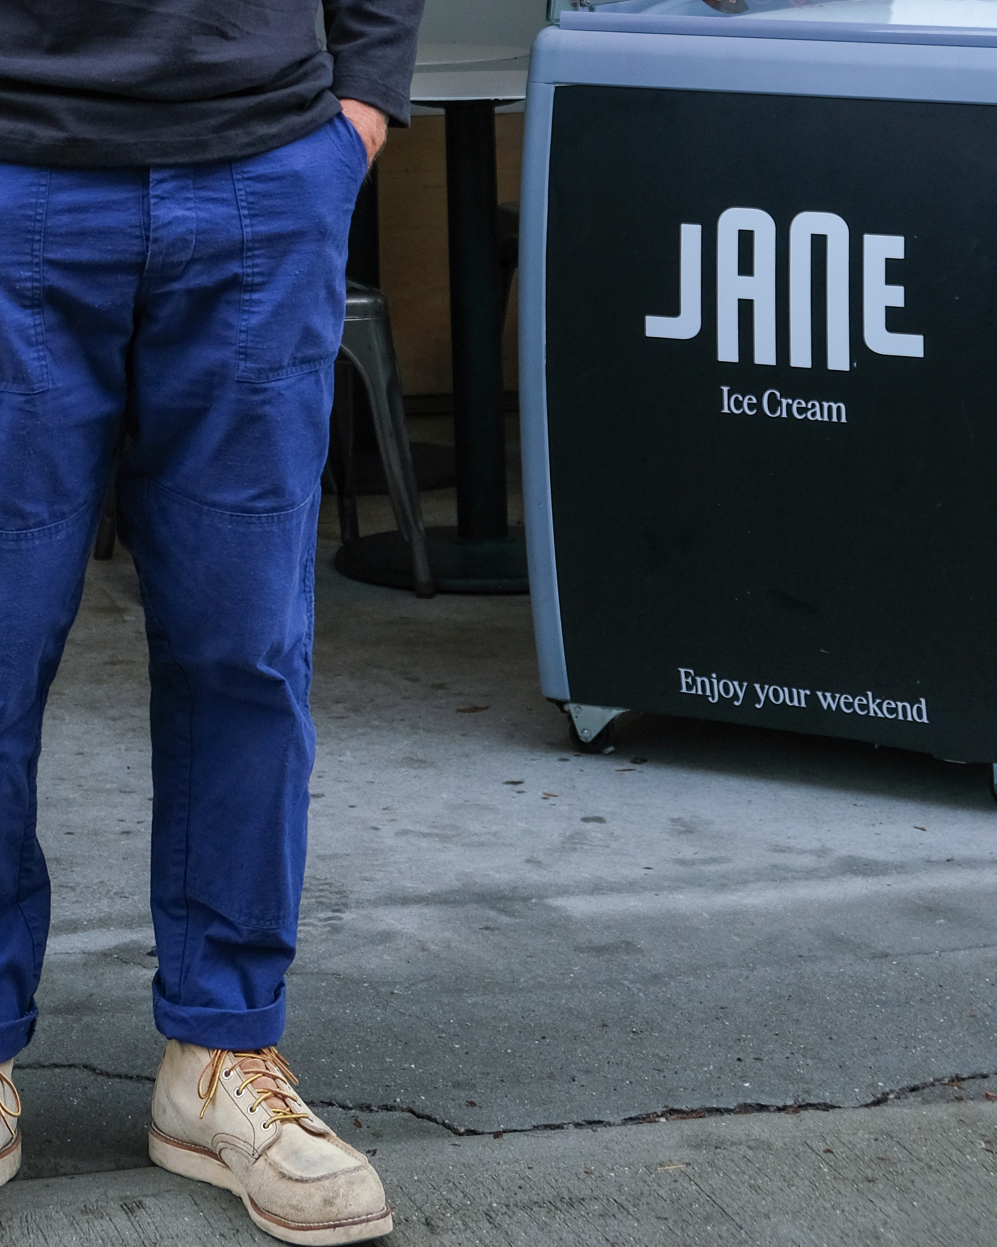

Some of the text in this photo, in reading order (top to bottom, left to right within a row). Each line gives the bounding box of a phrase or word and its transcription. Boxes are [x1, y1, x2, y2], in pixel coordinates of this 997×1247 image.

[645, 207, 924, 371] JANE
[720, 386, 847, 424] Ice Cream
[678, 666, 929, 724] Enjoy your weekend
